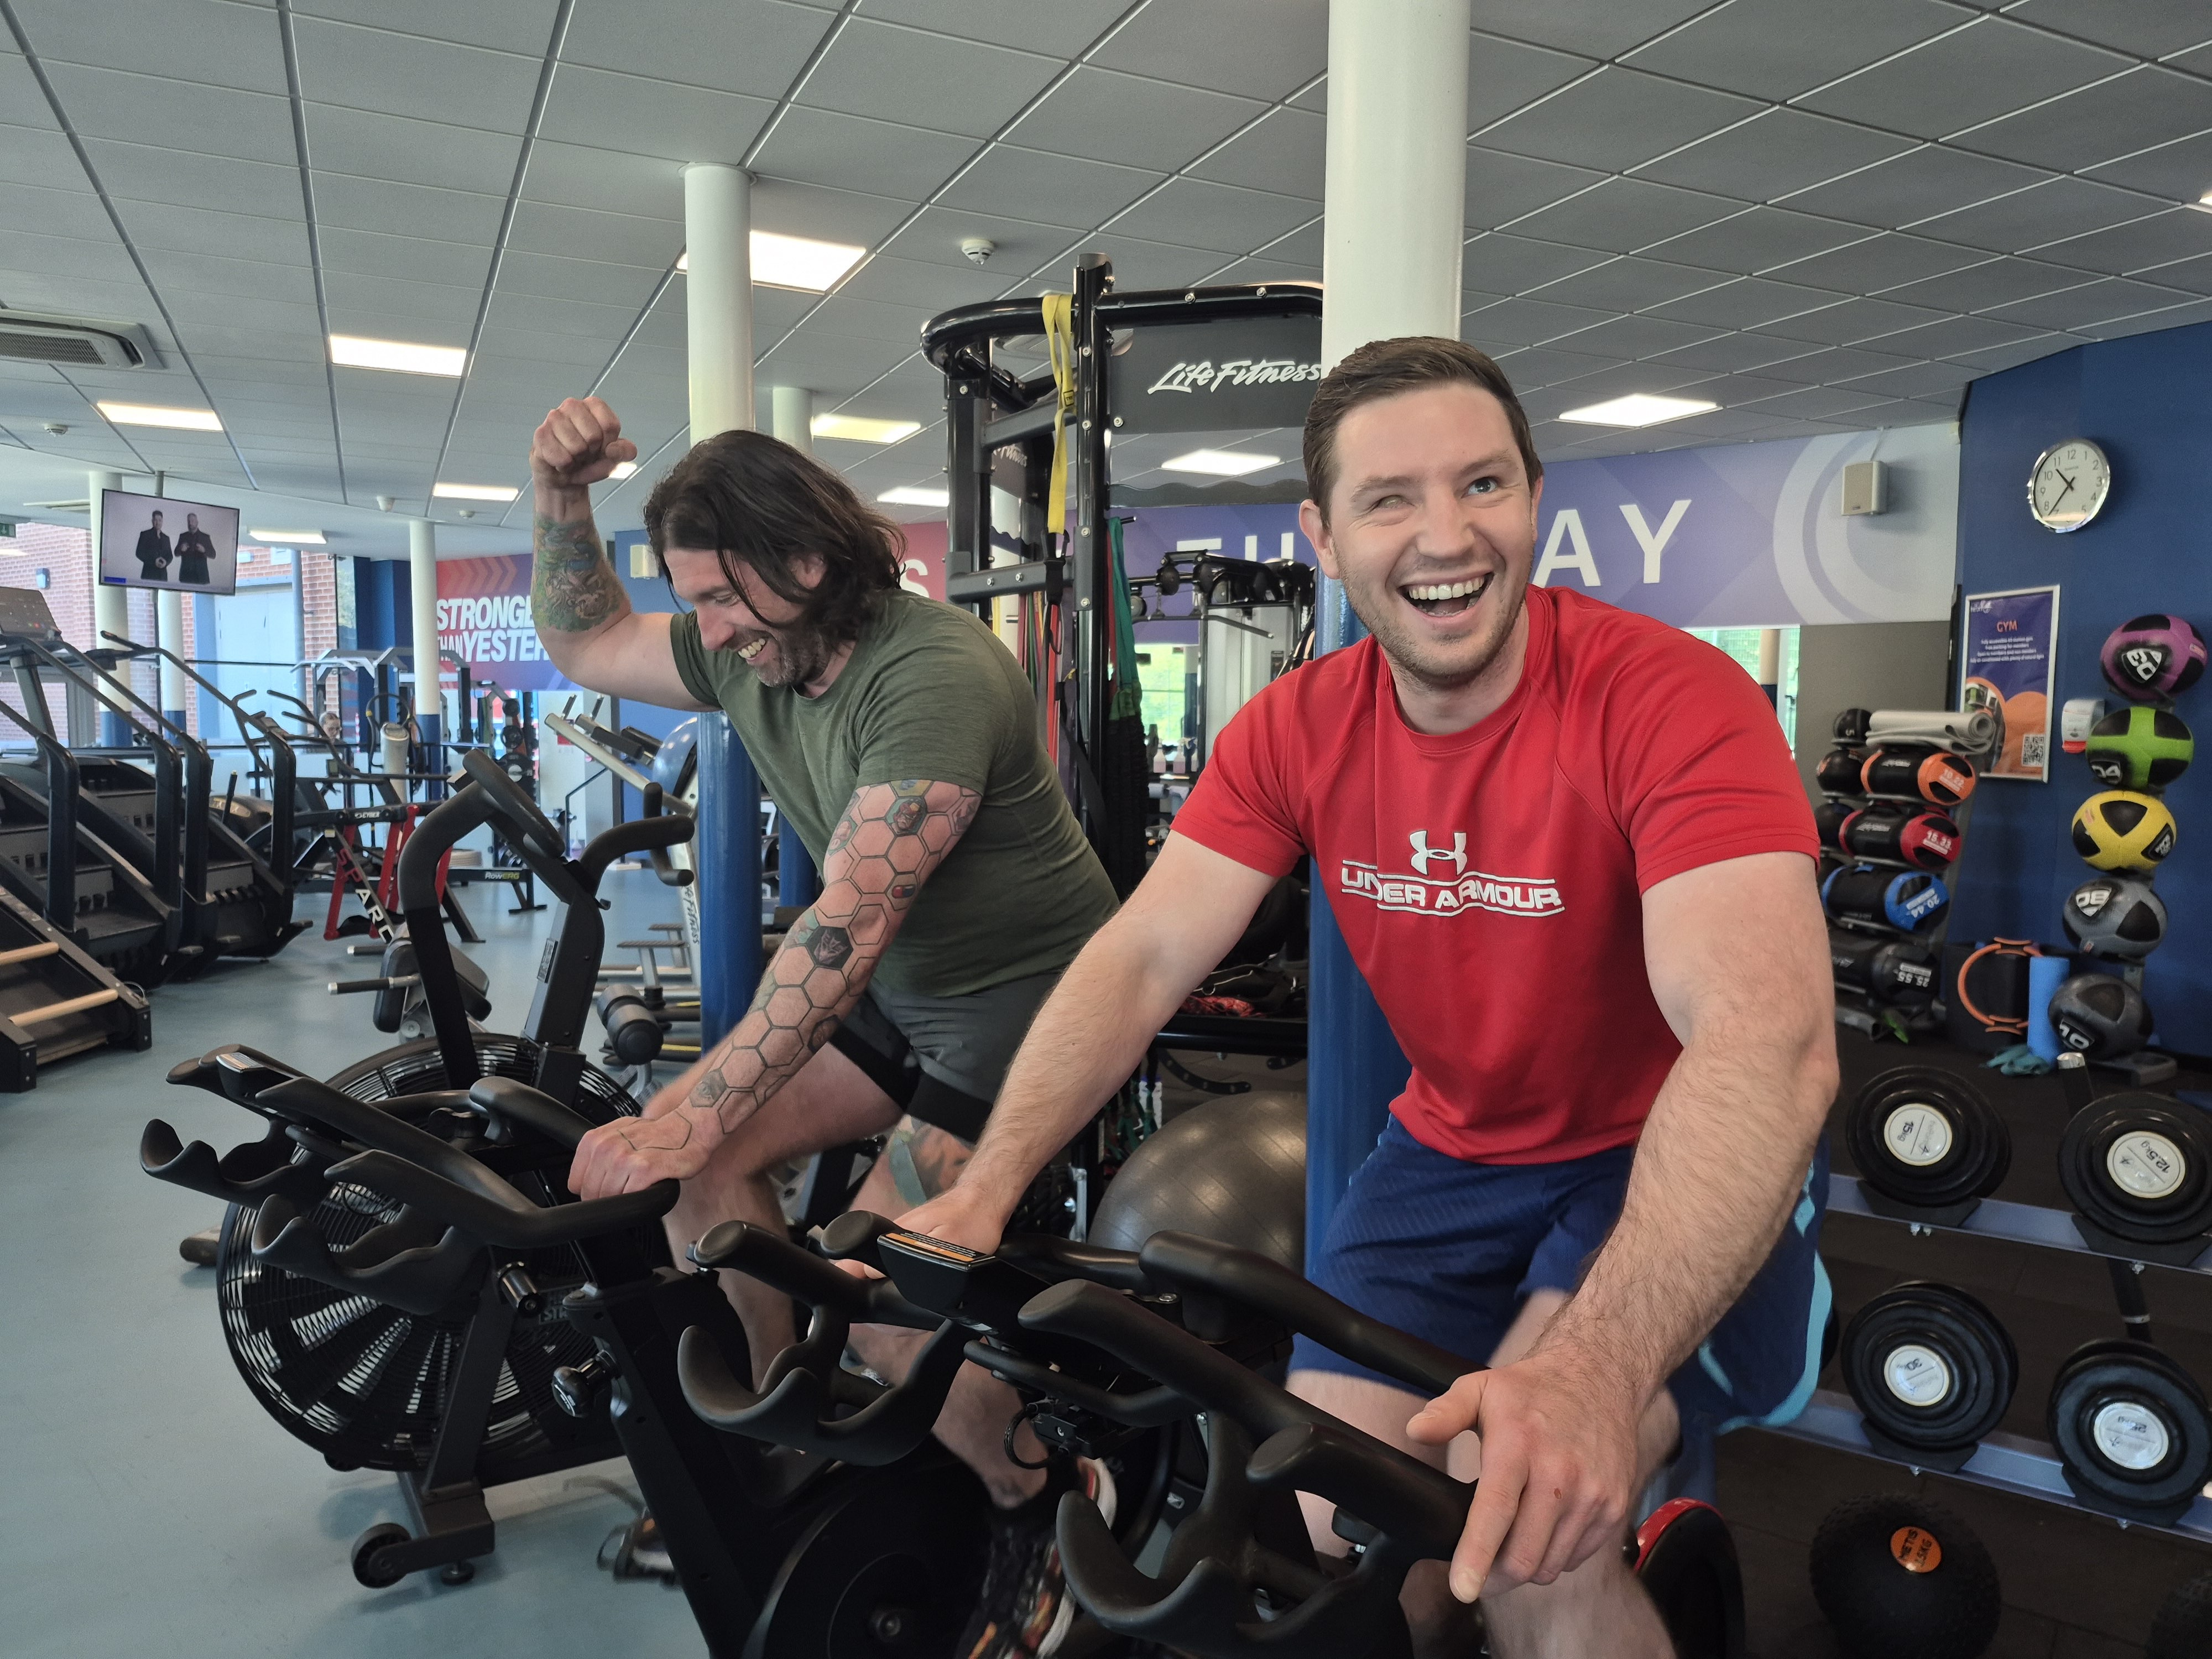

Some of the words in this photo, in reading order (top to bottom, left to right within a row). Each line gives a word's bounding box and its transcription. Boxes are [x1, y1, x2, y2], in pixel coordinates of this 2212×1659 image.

[1147, 361, 1215, 395] Life
[1210, 359, 1322, 393] Fitness
[2067, 449, 2077, 460] 12
[2084, 451, 2088, 461] 1
[2054, 456, 2061, 467] 11
[2093, 460, 2100, 470] 2
[2044, 471, 2053, 481] 10
[2096, 476, 2103, 487] 3
[2040, 487, 2046, 497] 9
[2090, 492, 2097, 502] 4
[2044, 500, 2049, 511] 8
[2081, 504, 2087, 513] 5
[1997, 620, 2018, 633] GYM
[2126, 650, 2157, 681] 03
[2091, 765, 2121, 779] 04
[485, 871, 520, 879] RowERG
[1434, 879, 1562, 910] ARMOUR
[2075, 889, 2110, 907] 08
[2059, 1023, 2089, 1050] 10
[1897, 1121, 1914, 1142] 15kg
[2141, 1140, 2171, 1173] 12.5kg
